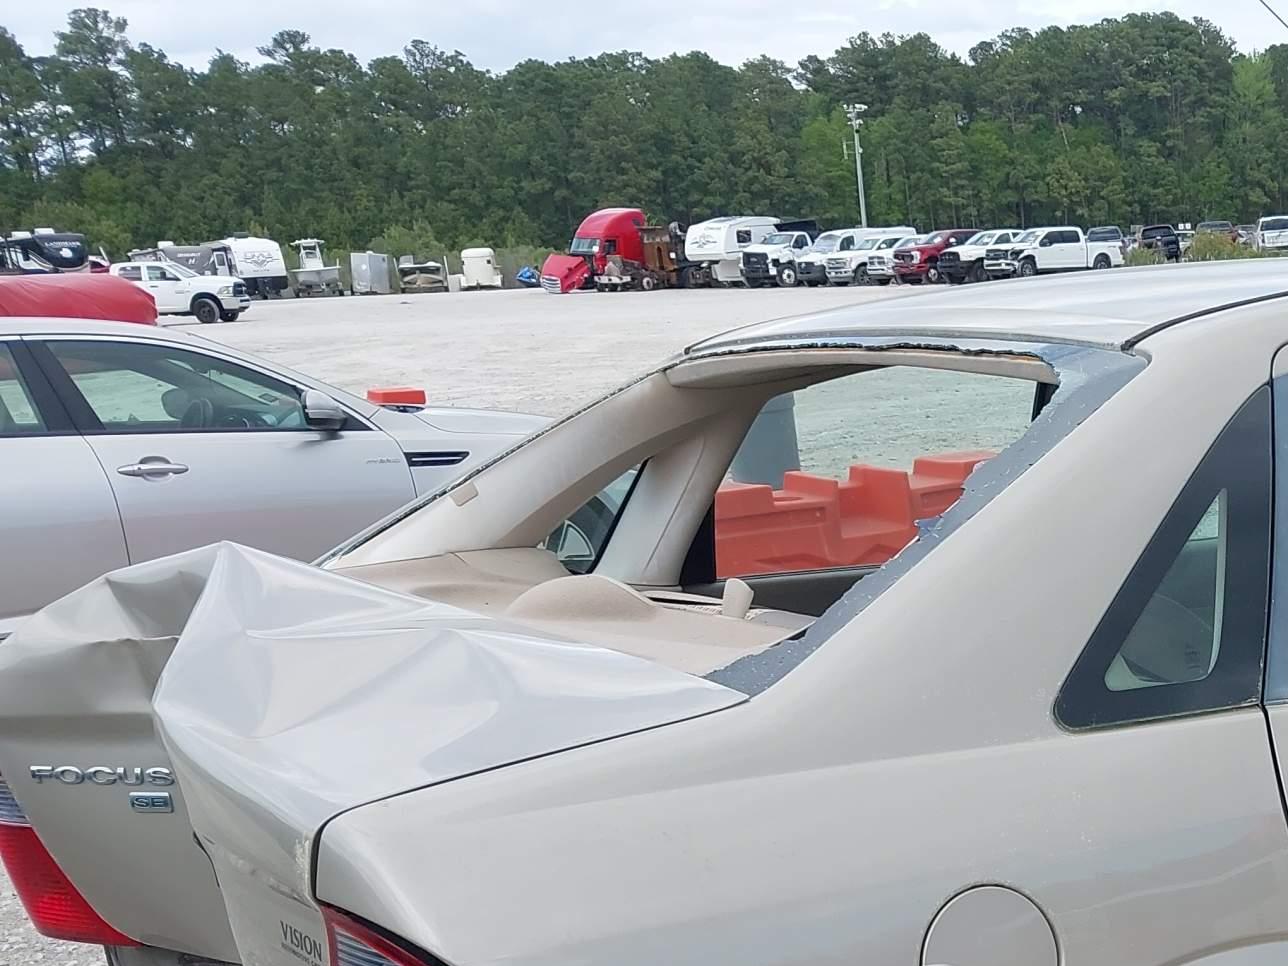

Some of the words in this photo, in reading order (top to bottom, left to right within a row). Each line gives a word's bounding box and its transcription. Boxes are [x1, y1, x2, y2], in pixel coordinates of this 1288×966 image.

[29, 765, 175, 786] FOCUS
[132, 795, 168, 808] SE
[279, 920, 323, 962] VISION
